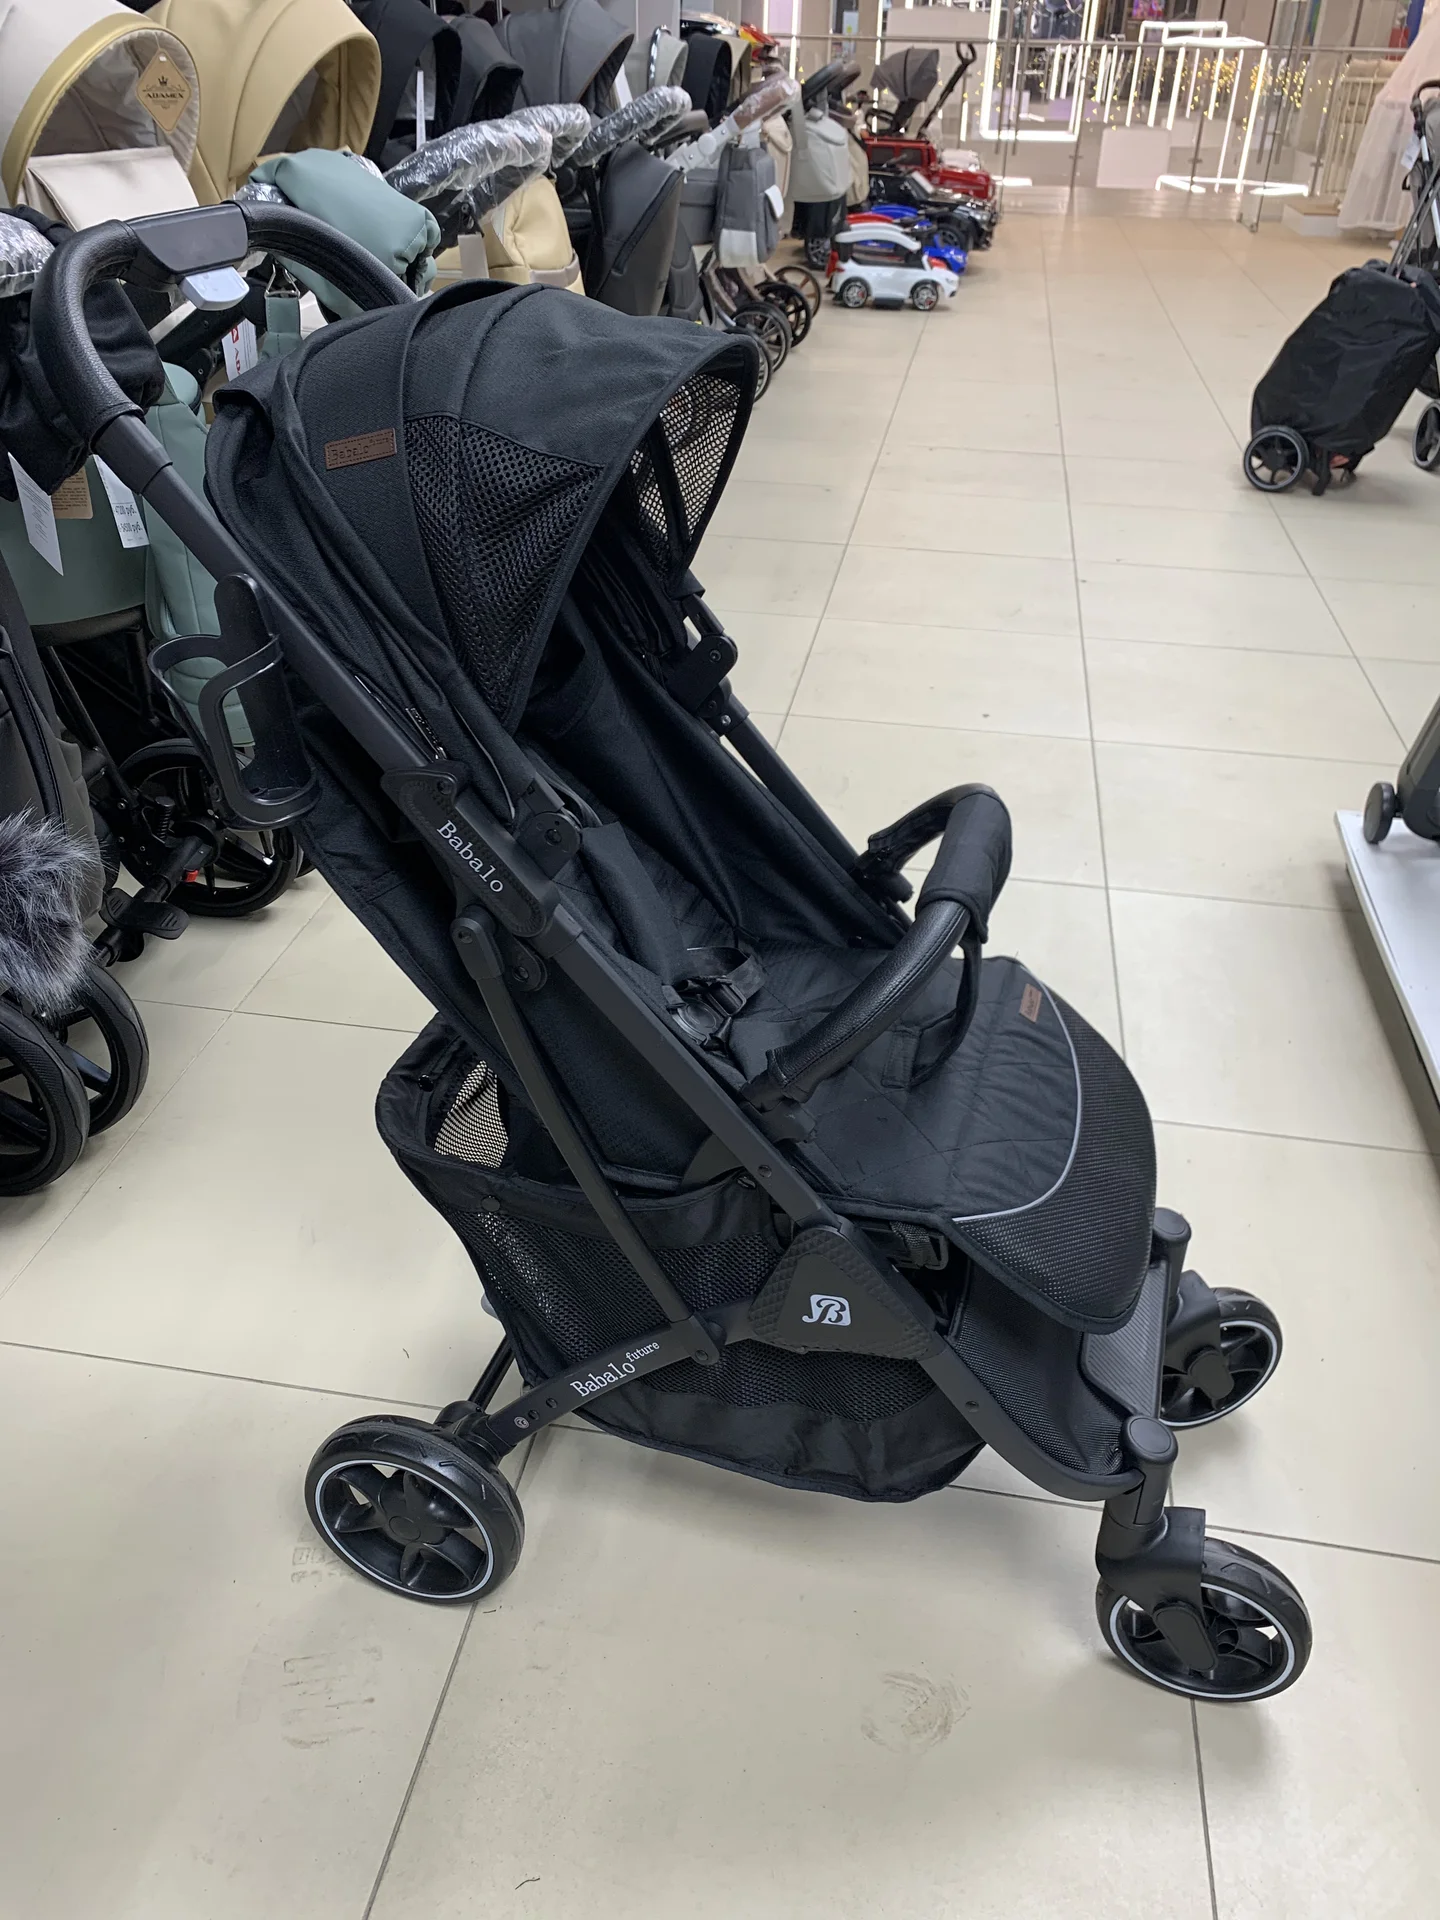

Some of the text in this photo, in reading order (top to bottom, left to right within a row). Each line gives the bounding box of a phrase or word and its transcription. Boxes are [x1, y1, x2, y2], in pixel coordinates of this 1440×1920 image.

[436, 819, 504, 892] Babalo
[569, 1341, 660, 1397] Babalo future
